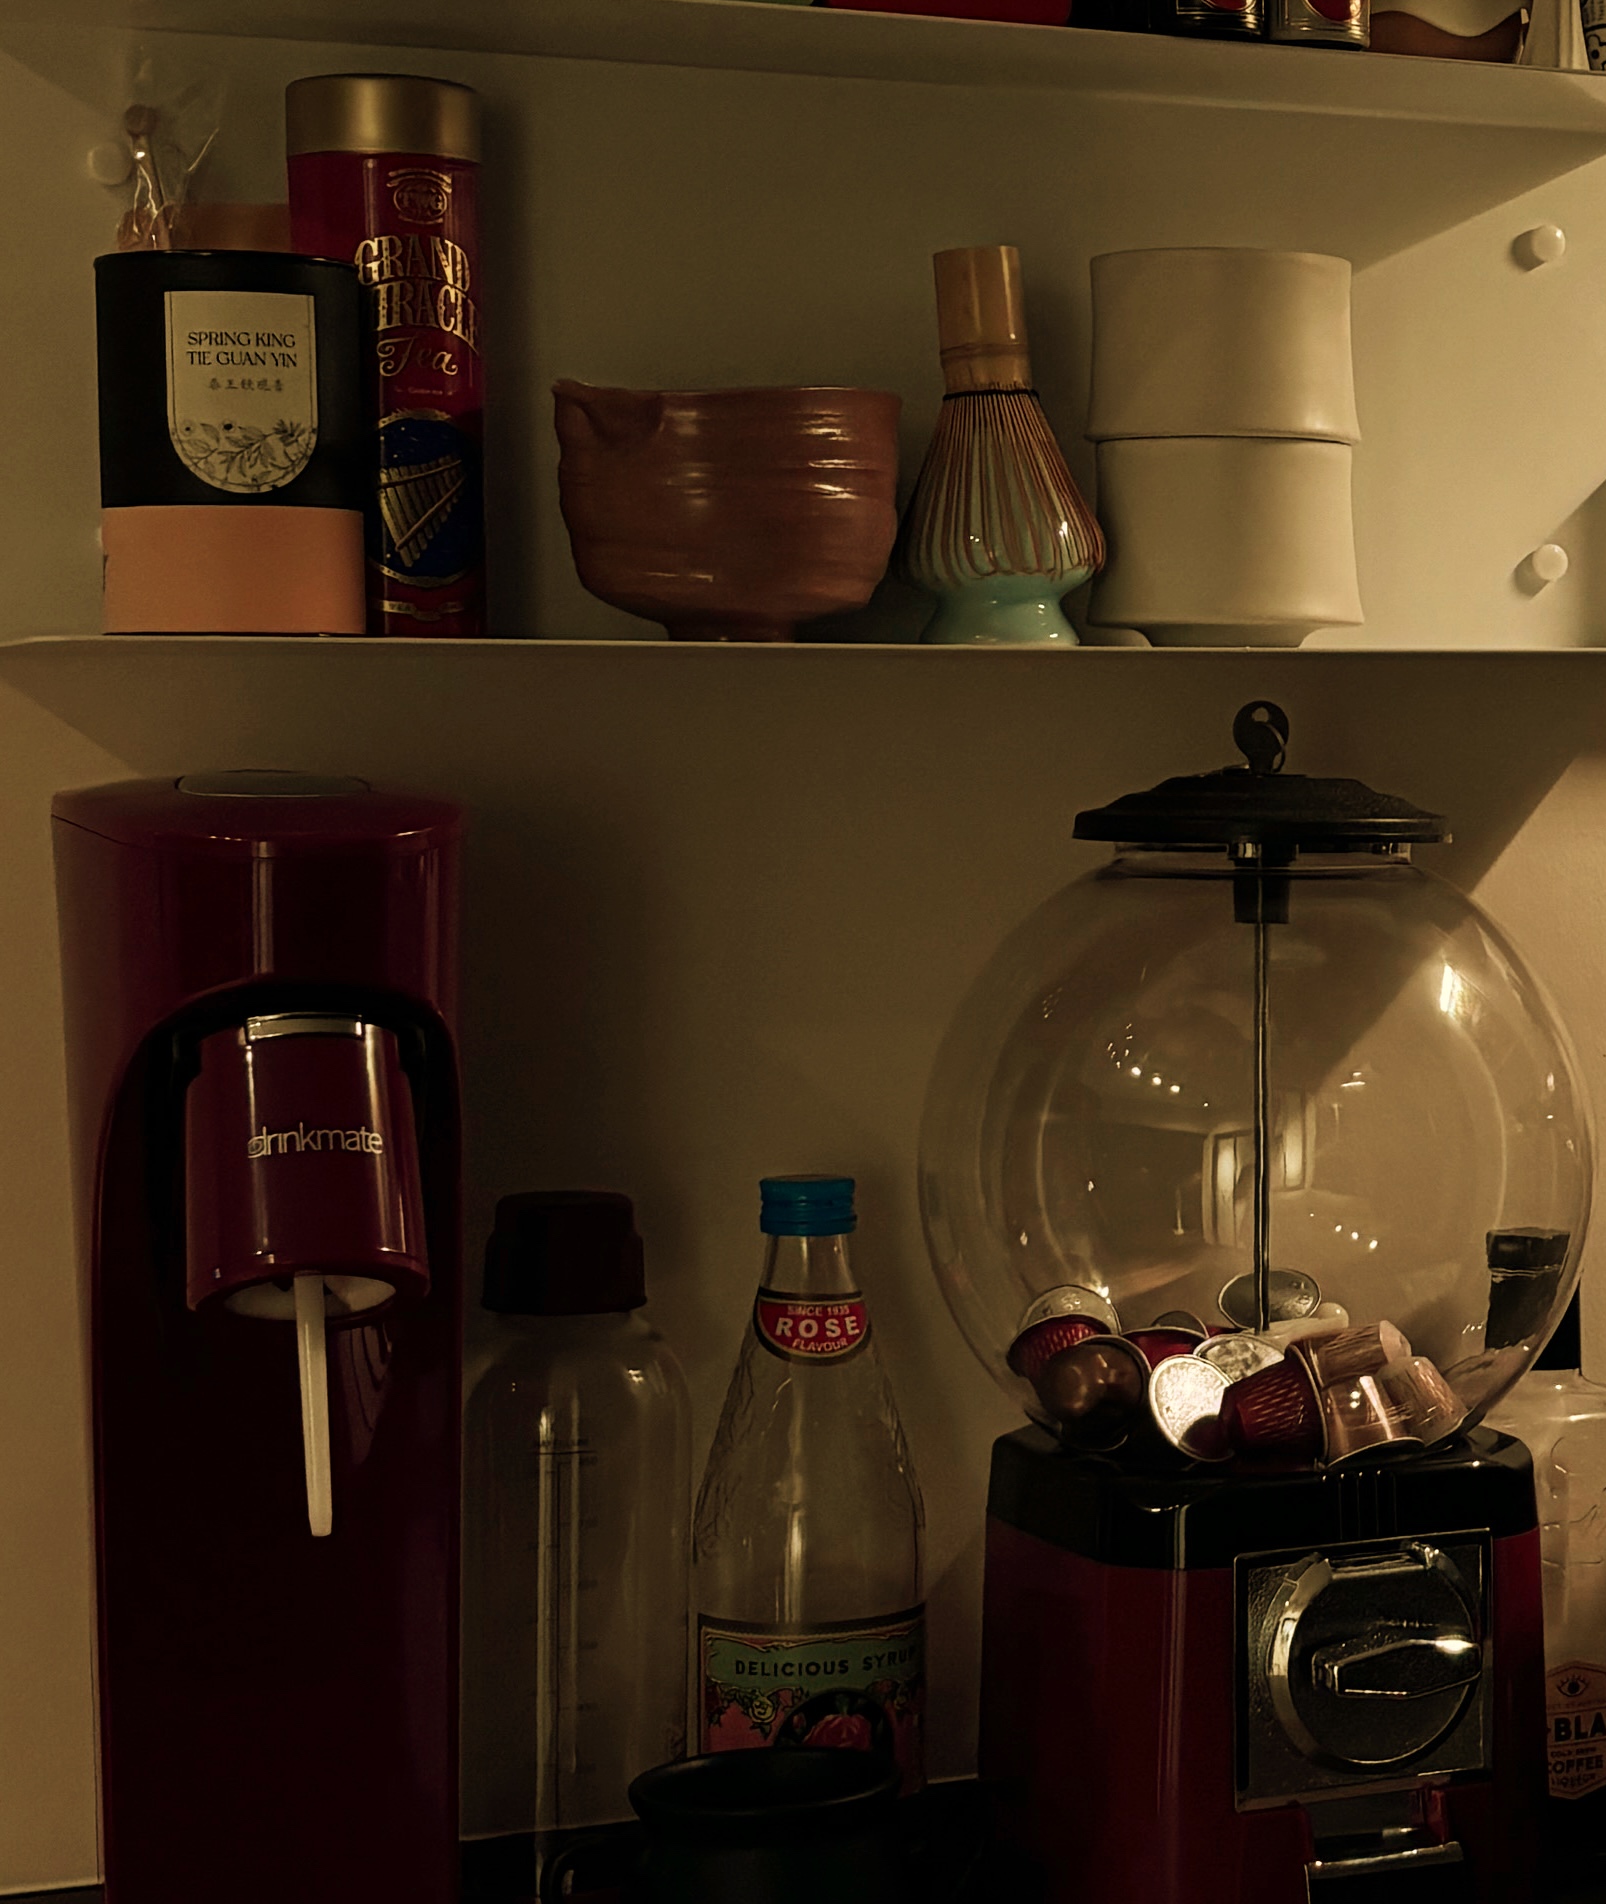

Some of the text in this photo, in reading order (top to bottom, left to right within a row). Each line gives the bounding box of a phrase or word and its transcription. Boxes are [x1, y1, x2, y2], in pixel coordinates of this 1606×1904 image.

[354, 233, 471, 298] GRAND
[187, 330, 296, 348] SPRING KING
[186, 350, 298, 369] TIE GUAN YIN
[376, 337, 459, 377] Tea
[247, 1121, 384, 1159] drinkmate
[775, 1315, 861, 1338] ROSE
[791, 1337, 849, 1353] FLAVOUR
[735, 1659, 850, 1677] DELICIOUS
